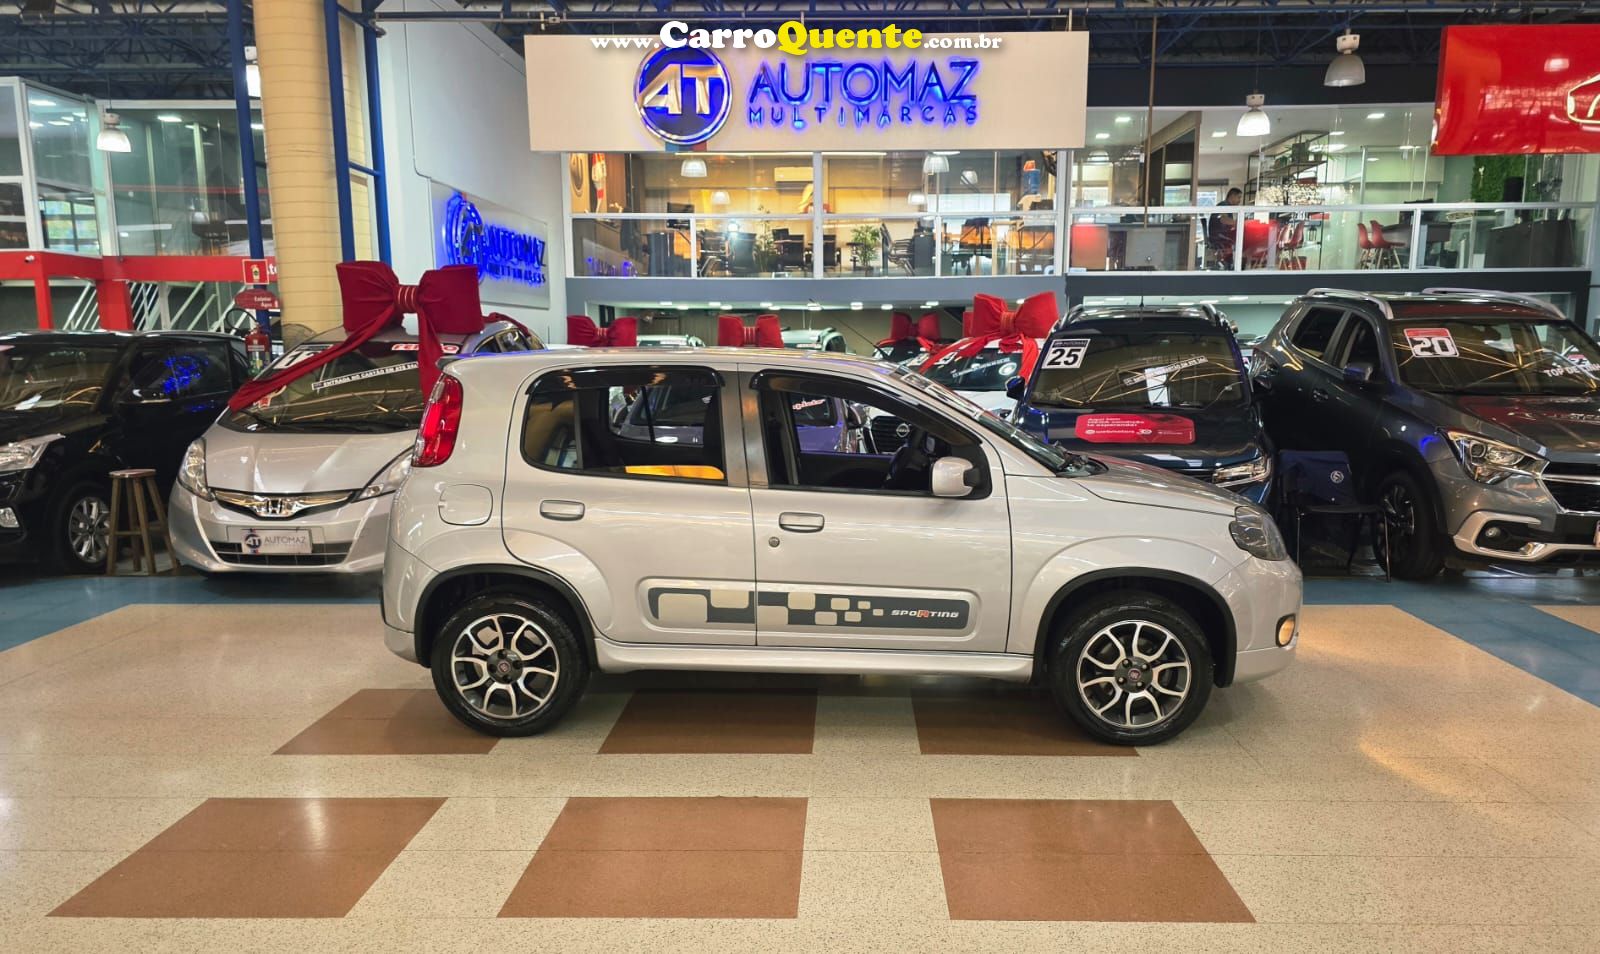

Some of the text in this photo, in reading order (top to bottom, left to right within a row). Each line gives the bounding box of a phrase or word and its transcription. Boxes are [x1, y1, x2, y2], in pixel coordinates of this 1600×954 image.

[637, 63, 724, 115] AT
[749, 60, 979, 103] AUTOMAZ
[749, 106, 979, 124] MULTIMARCAS
[1412, 337, 1456, 355] 20
[1046, 348, 1082, 366] 25
[1544, 367, 1565, 377] TOP
[264, 536, 306, 544] AUTOMAZ
[891, 609, 960, 618] SPORTING
